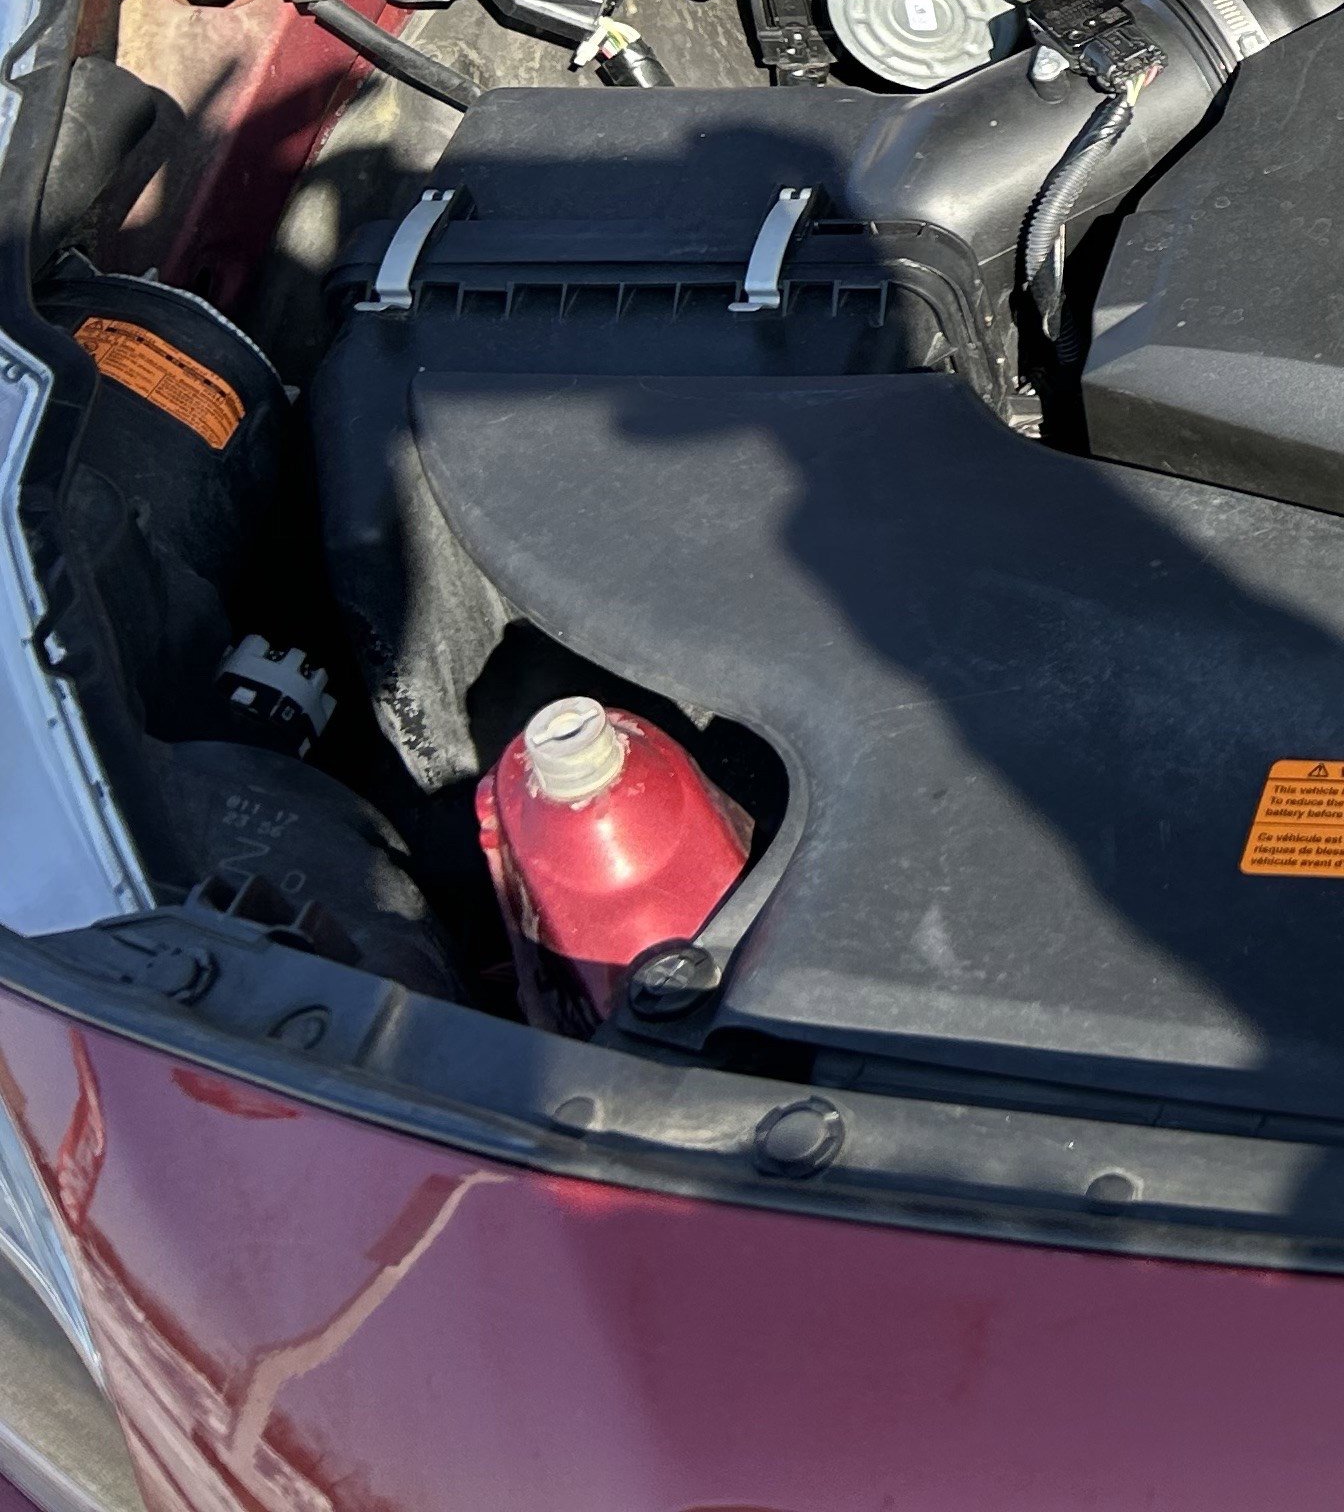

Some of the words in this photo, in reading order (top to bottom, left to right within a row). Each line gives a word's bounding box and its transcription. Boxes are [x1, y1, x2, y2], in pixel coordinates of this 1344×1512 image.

[1300, 785, 1339, 796] vehicle
[1286, 796, 1324, 806] reduce
[1307, 809, 1343, 819] before
